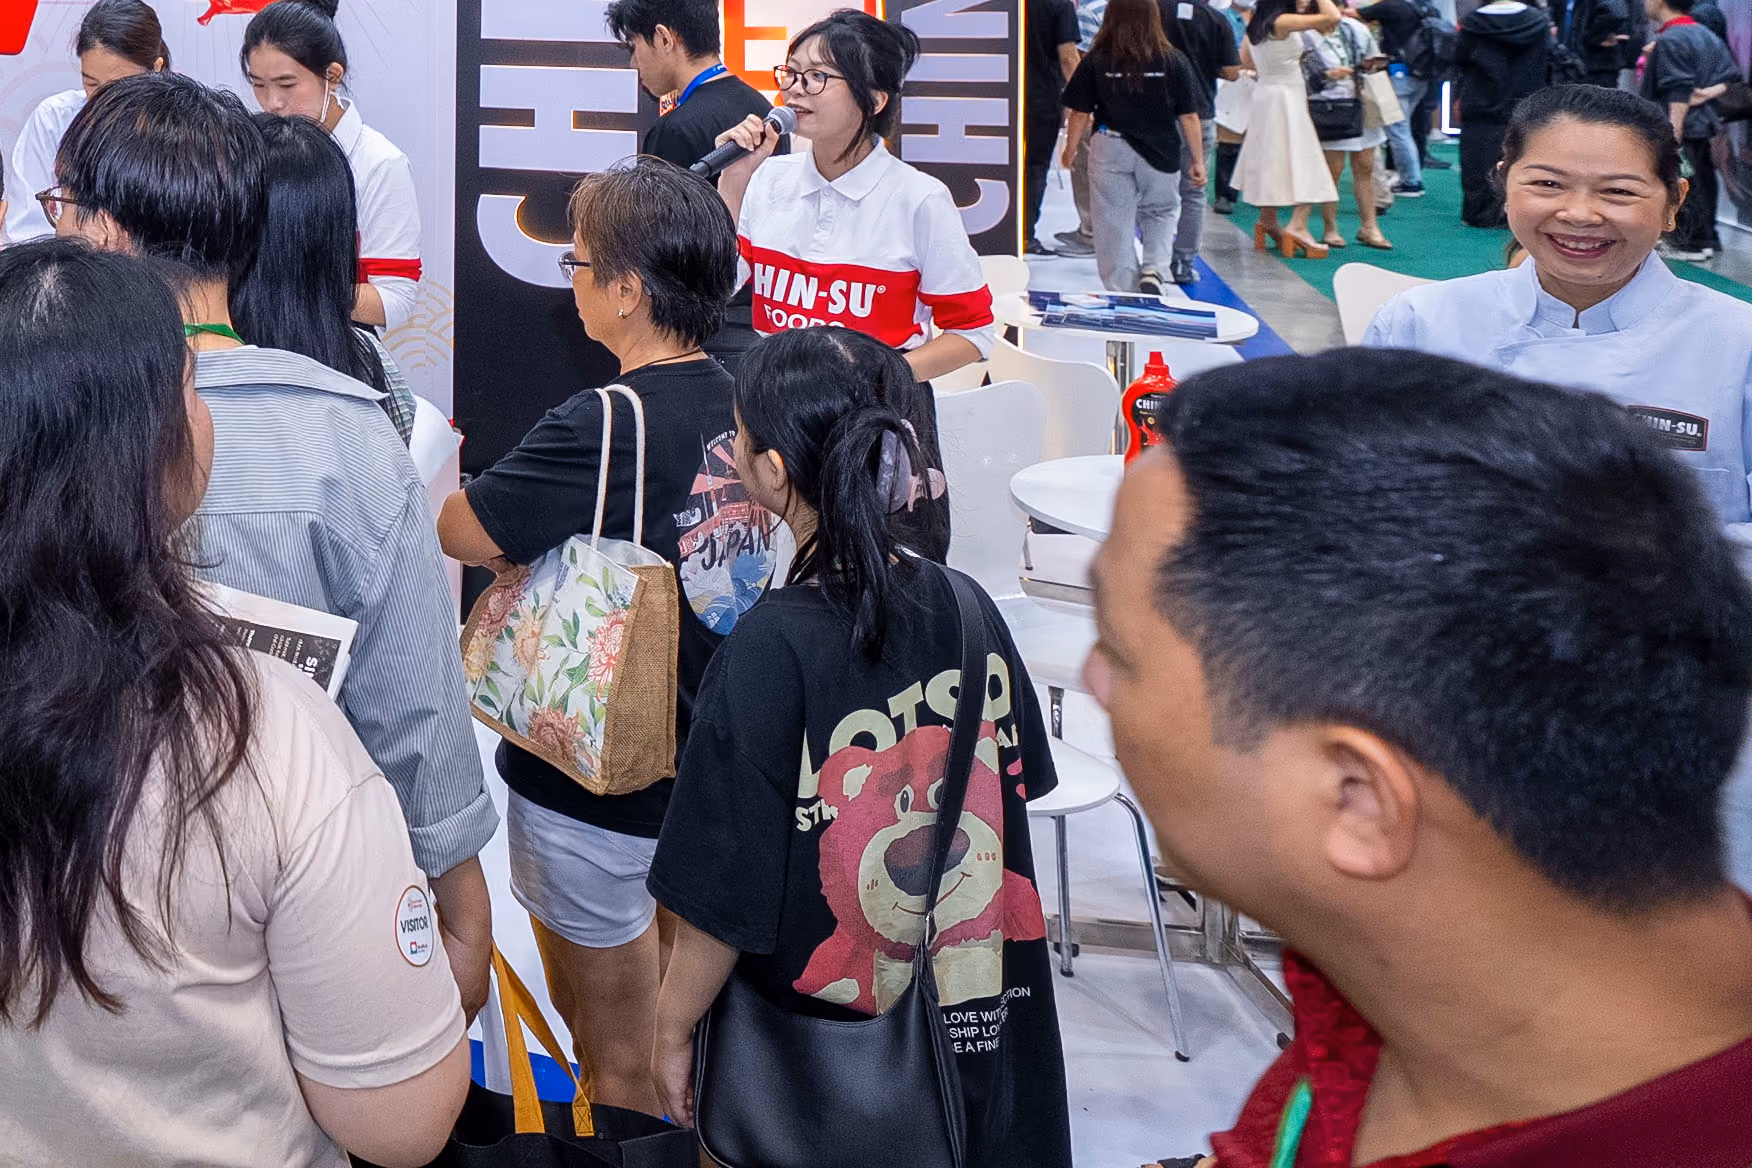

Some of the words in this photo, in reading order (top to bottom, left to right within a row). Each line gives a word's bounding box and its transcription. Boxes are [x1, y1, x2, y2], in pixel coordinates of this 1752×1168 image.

[754, 262, 876, 318] HIN-SU
[1637, 414, 1698, 436] HIN-SU
[400, 916, 428, 933] VISITOR
[943, 1011, 978, 1024] LOVE
[949, 1027, 979, 1039] SHIP
[965, 1041, 975, 1052] A
